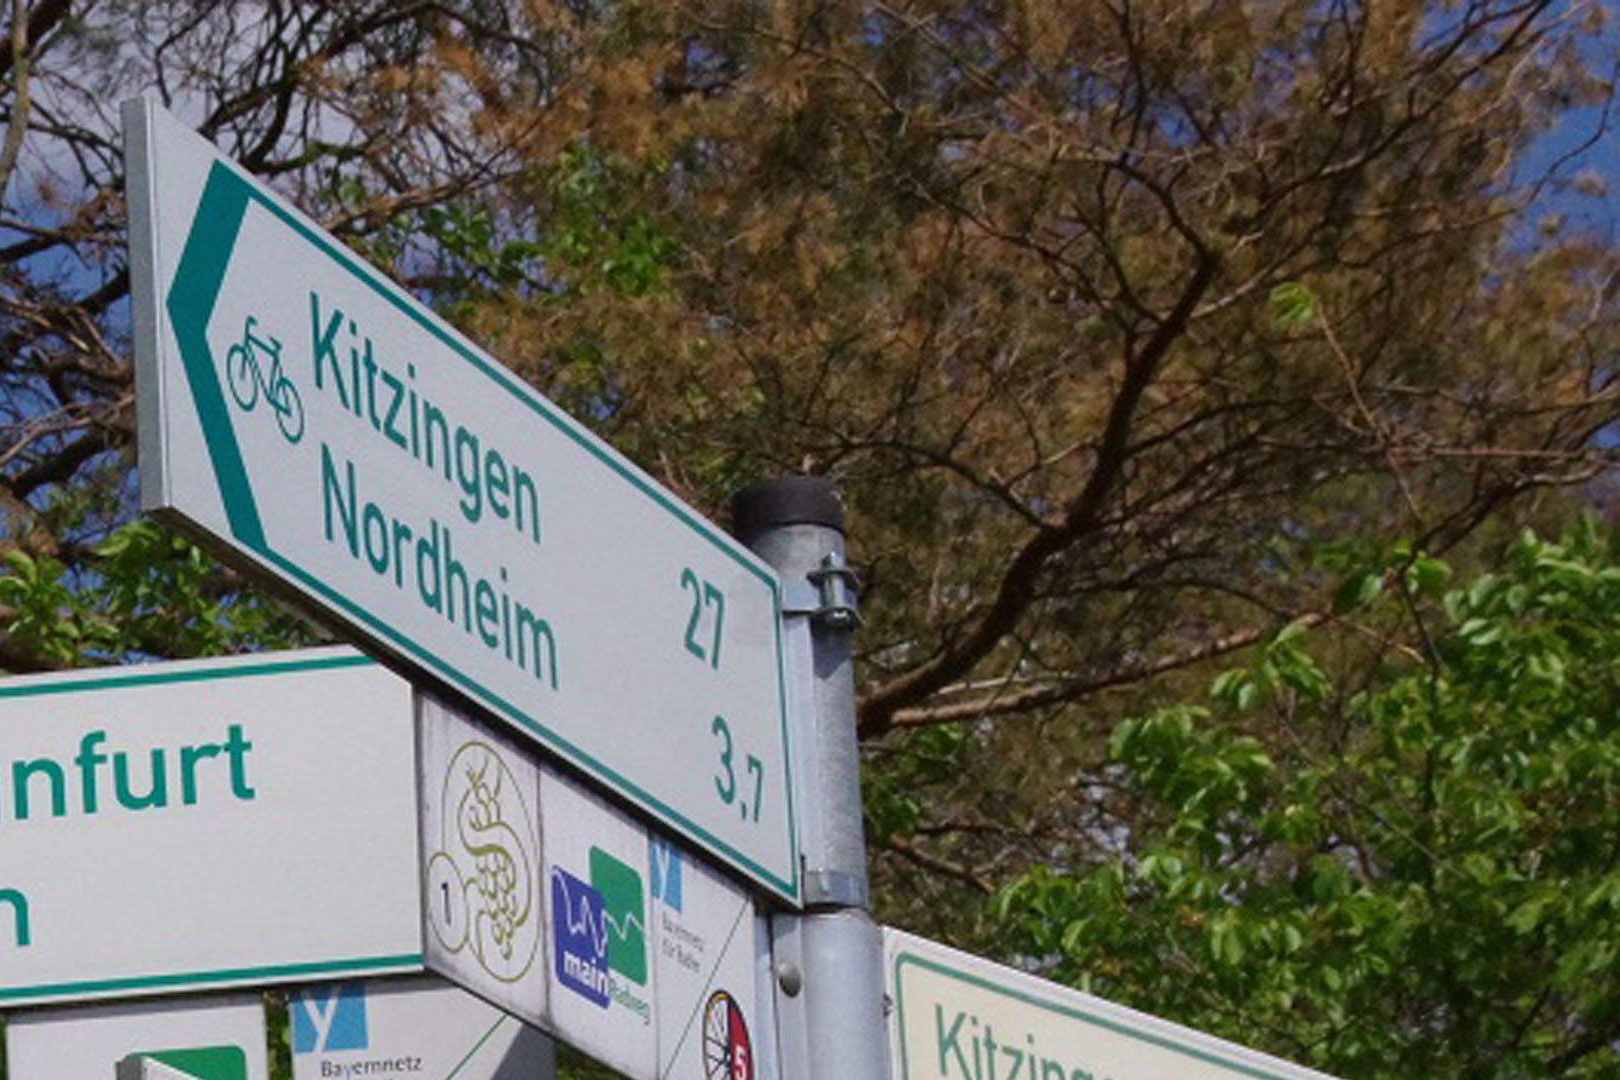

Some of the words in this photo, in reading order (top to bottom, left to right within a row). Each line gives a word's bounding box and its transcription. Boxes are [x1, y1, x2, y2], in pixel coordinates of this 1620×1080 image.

[310, 291, 541, 544] Kitzingen
[680, 568, 725, 670] 27
[321, 443, 560, 691] Nordheim
[711, 715, 764, 824] 3,7
[440, 882, 453, 926] 1
[564, 951, 610, 997] main
[320, 1055, 423, 1079] Bayernnetz
